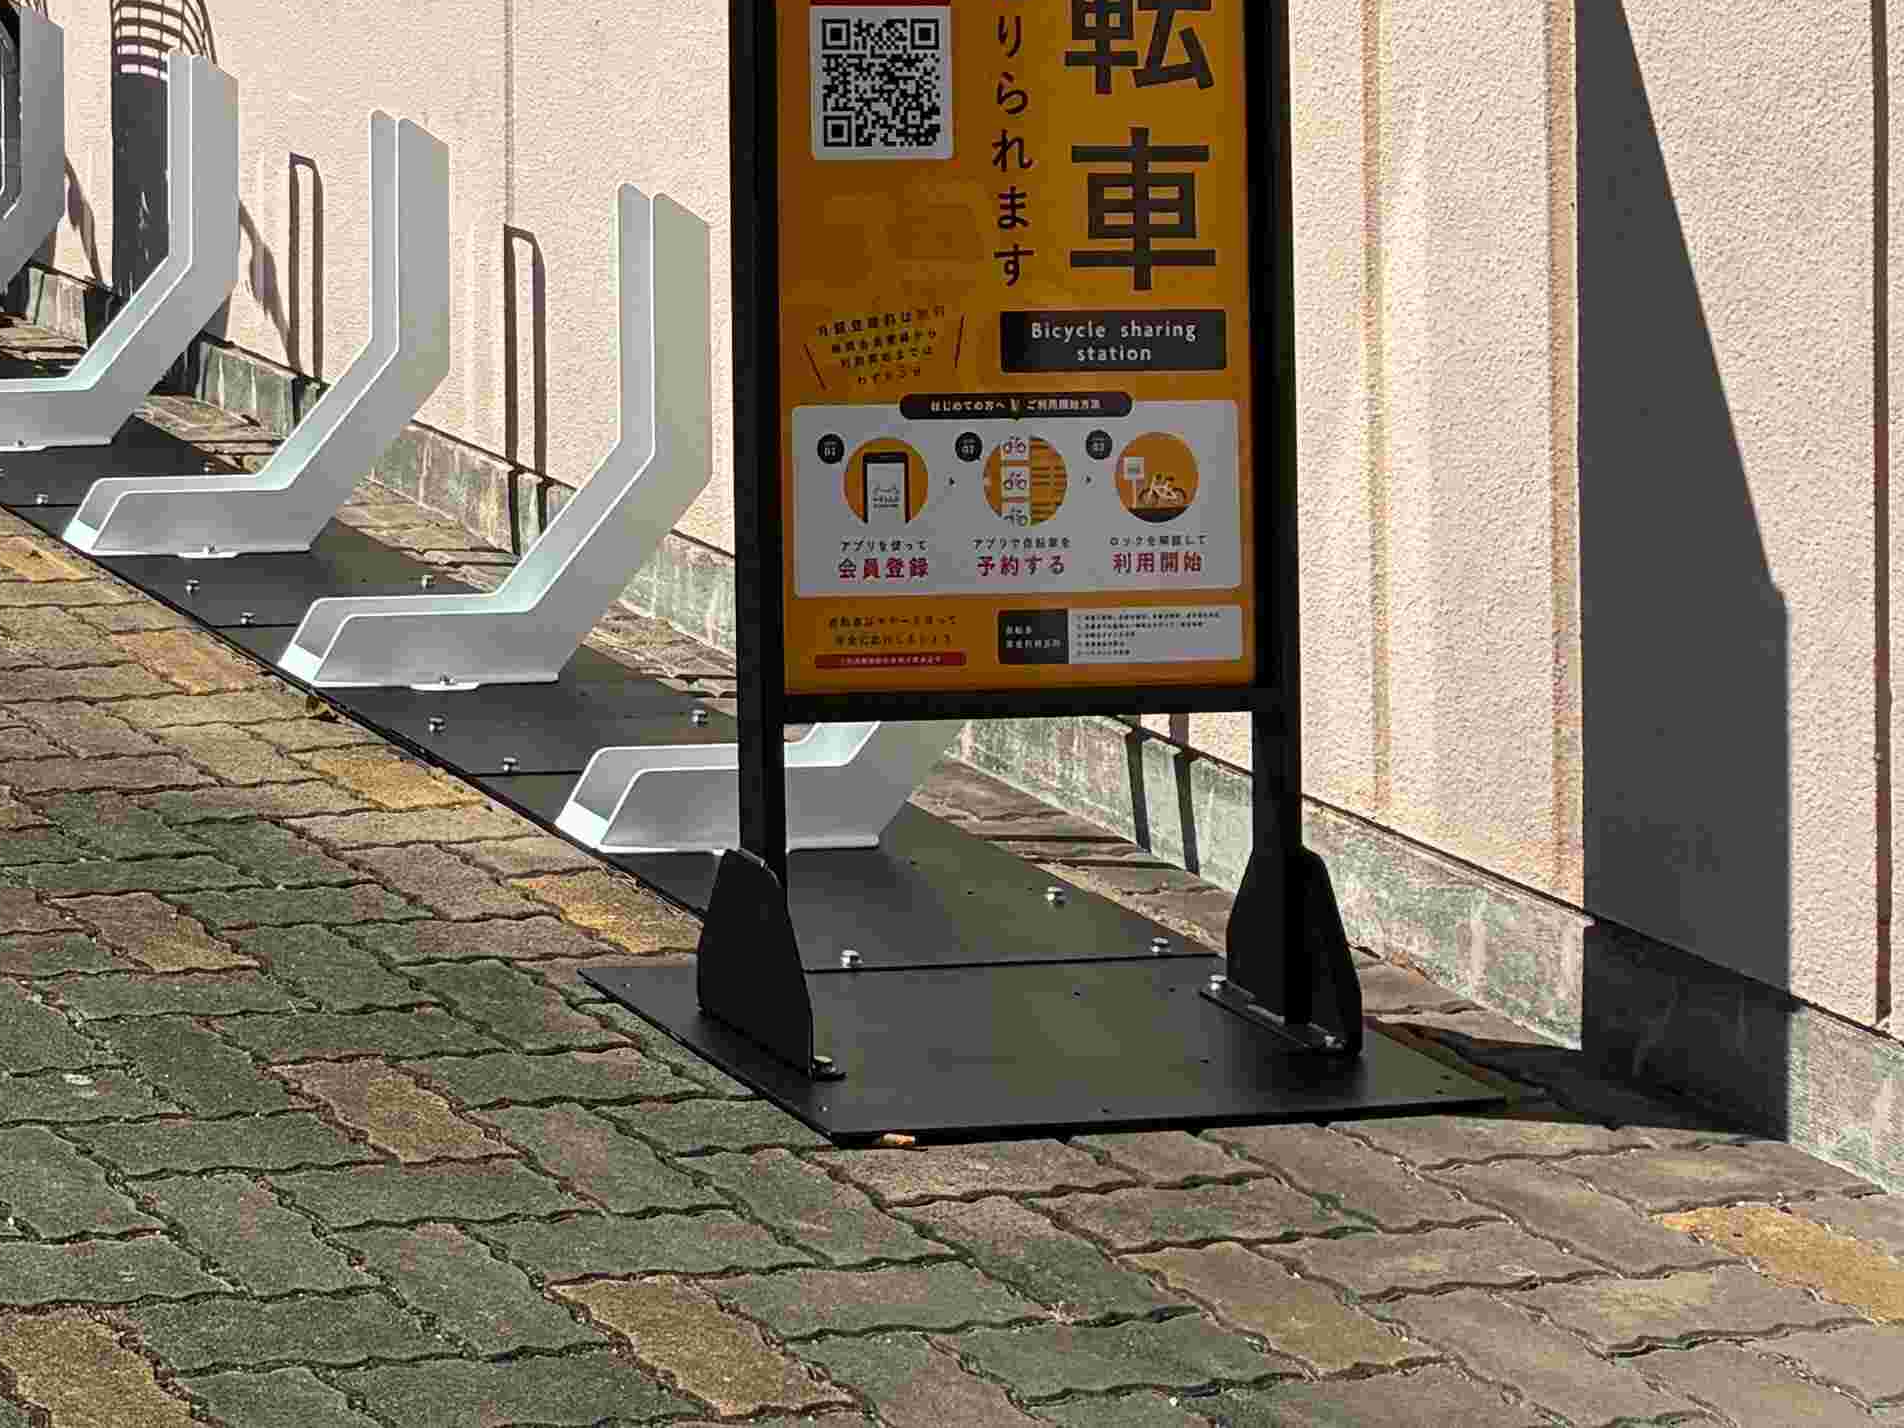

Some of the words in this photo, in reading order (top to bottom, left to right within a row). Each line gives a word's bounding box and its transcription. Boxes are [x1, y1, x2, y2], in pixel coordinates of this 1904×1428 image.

[1031, 319, 1106, 343] Bicycle
[1120, 319, 1197, 342] sharing
[1076, 345, 1153, 362] station
[837, 557, 929, 579] 会員登録
[976, 555, 1066, 576] 予約する
[1110, 551, 1202, 574] 利用開始
